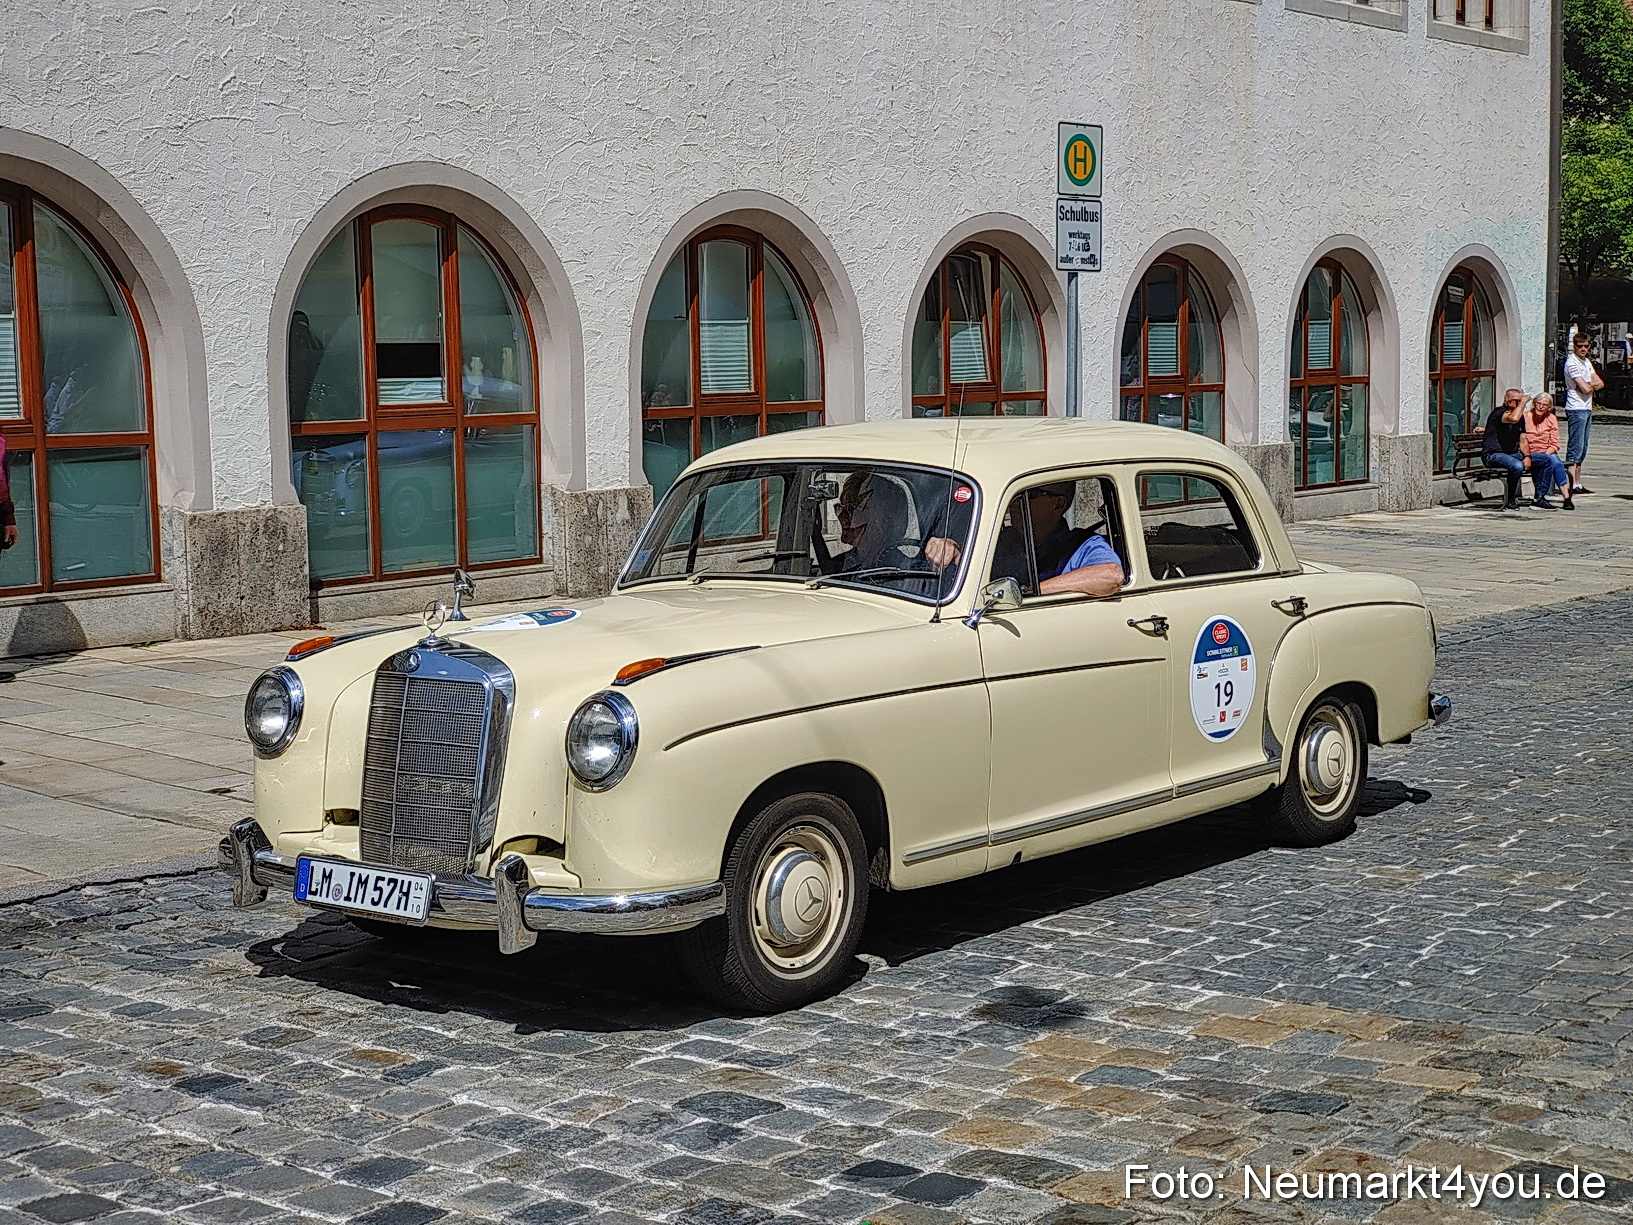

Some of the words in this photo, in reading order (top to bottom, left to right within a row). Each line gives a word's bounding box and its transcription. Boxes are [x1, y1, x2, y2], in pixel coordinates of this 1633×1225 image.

[1074, 145, 1087, 175] H
[1059, 205, 1099, 222] Schulbus
[1068, 230, 1091, 241] werktags
[1060, 254, 1074, 264] außer
[1215, 680, 1234, 707] 19
[300, 883, 305, 892] D
[308, 865, 334, 898] LM
[343, 871, 370, 904] IM
[370, 876, 412, 911] 57H
